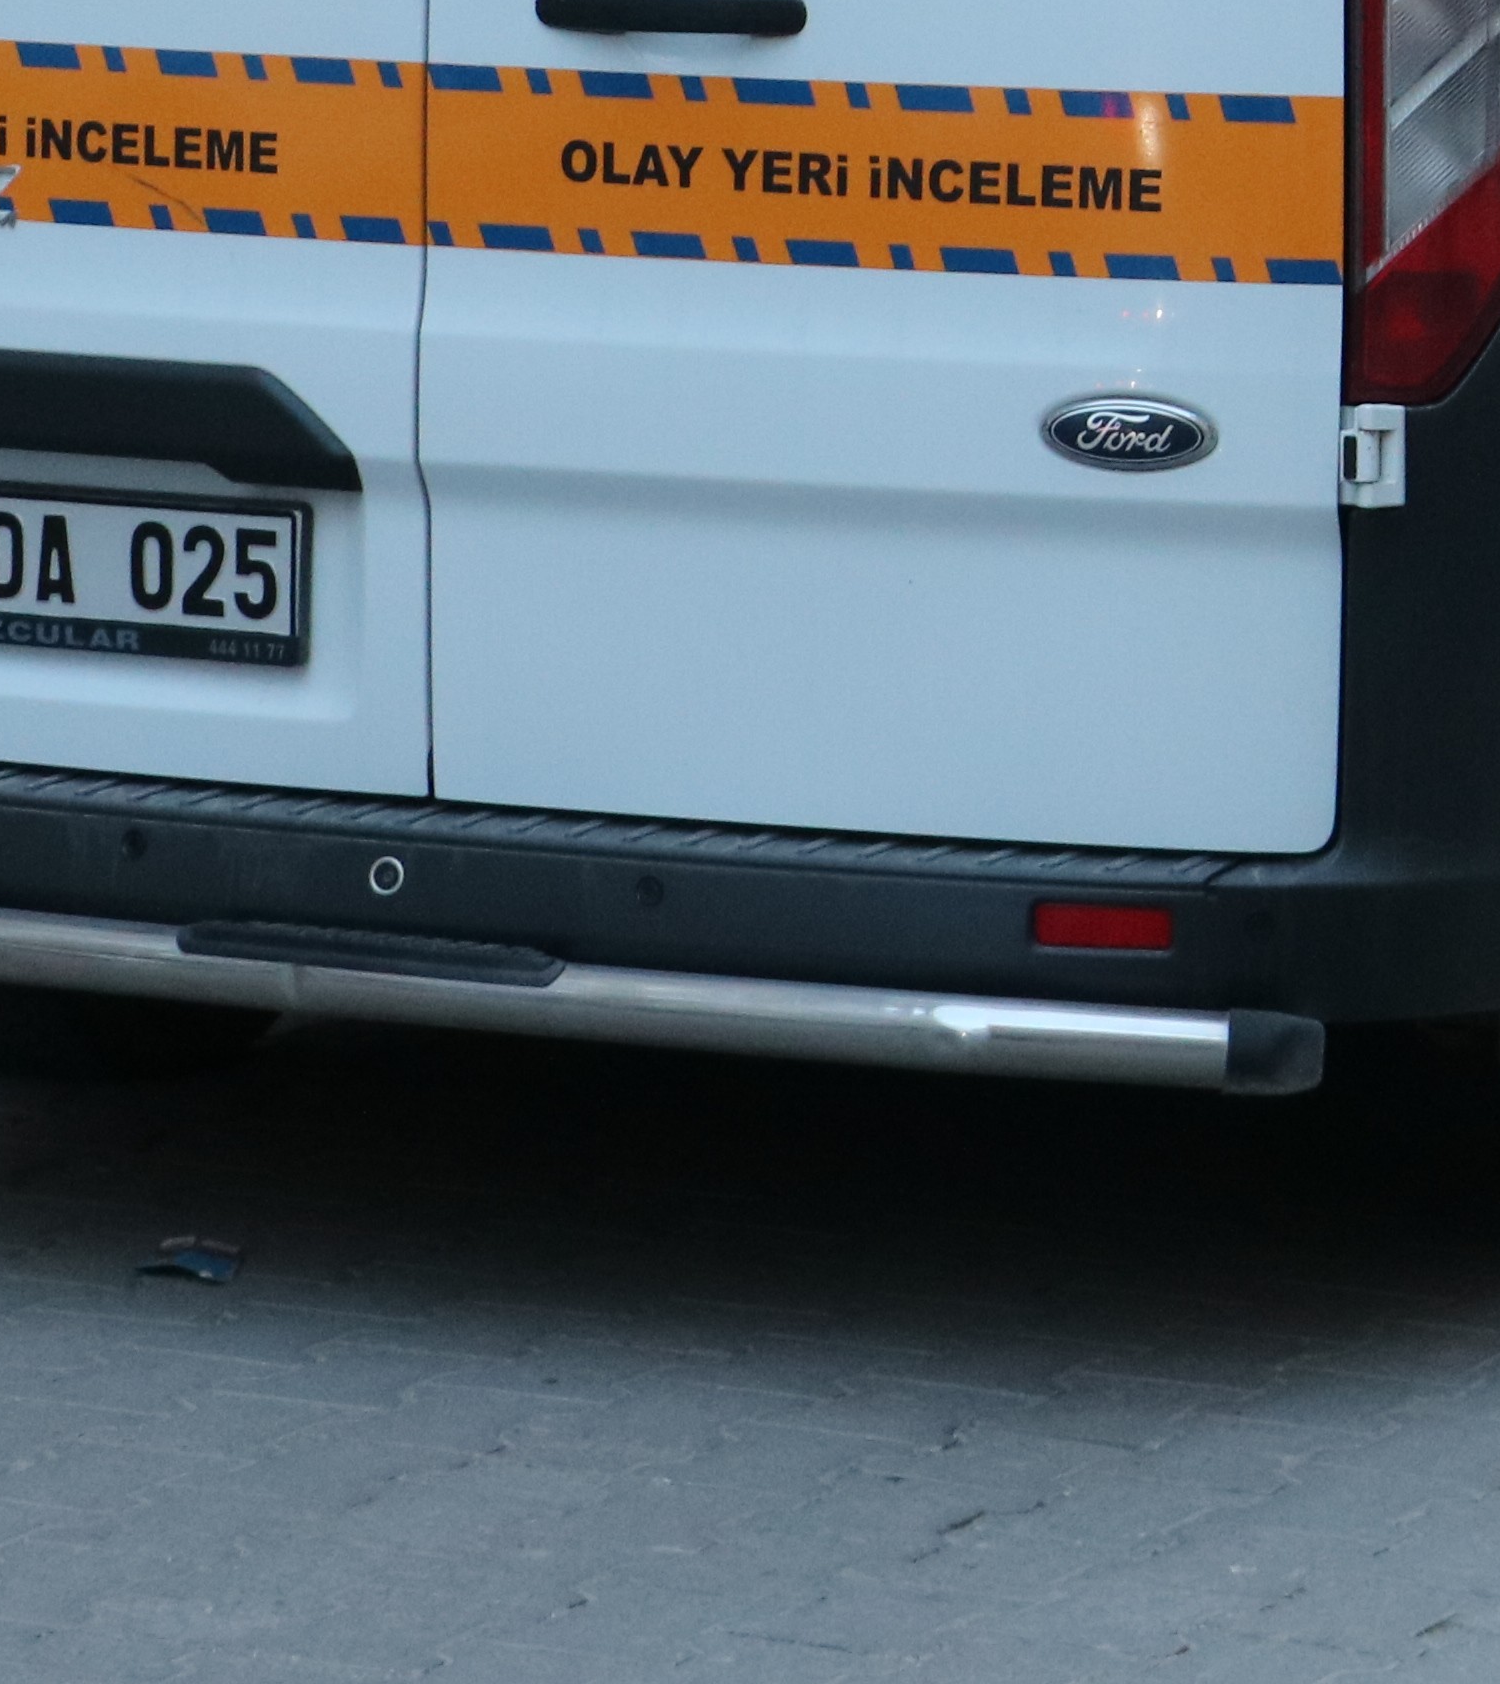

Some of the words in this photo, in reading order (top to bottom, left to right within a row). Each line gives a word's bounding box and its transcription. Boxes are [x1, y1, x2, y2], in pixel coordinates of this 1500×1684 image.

[559, 138, 704, 190] OLAY
[1076, 410, 1174, 454] Ford
[129, 520, 279, 620] 025
[208, 637, 238, 657] 444
[243, 640, 261, 658] 11
[265, 642, 287, 660] 77
